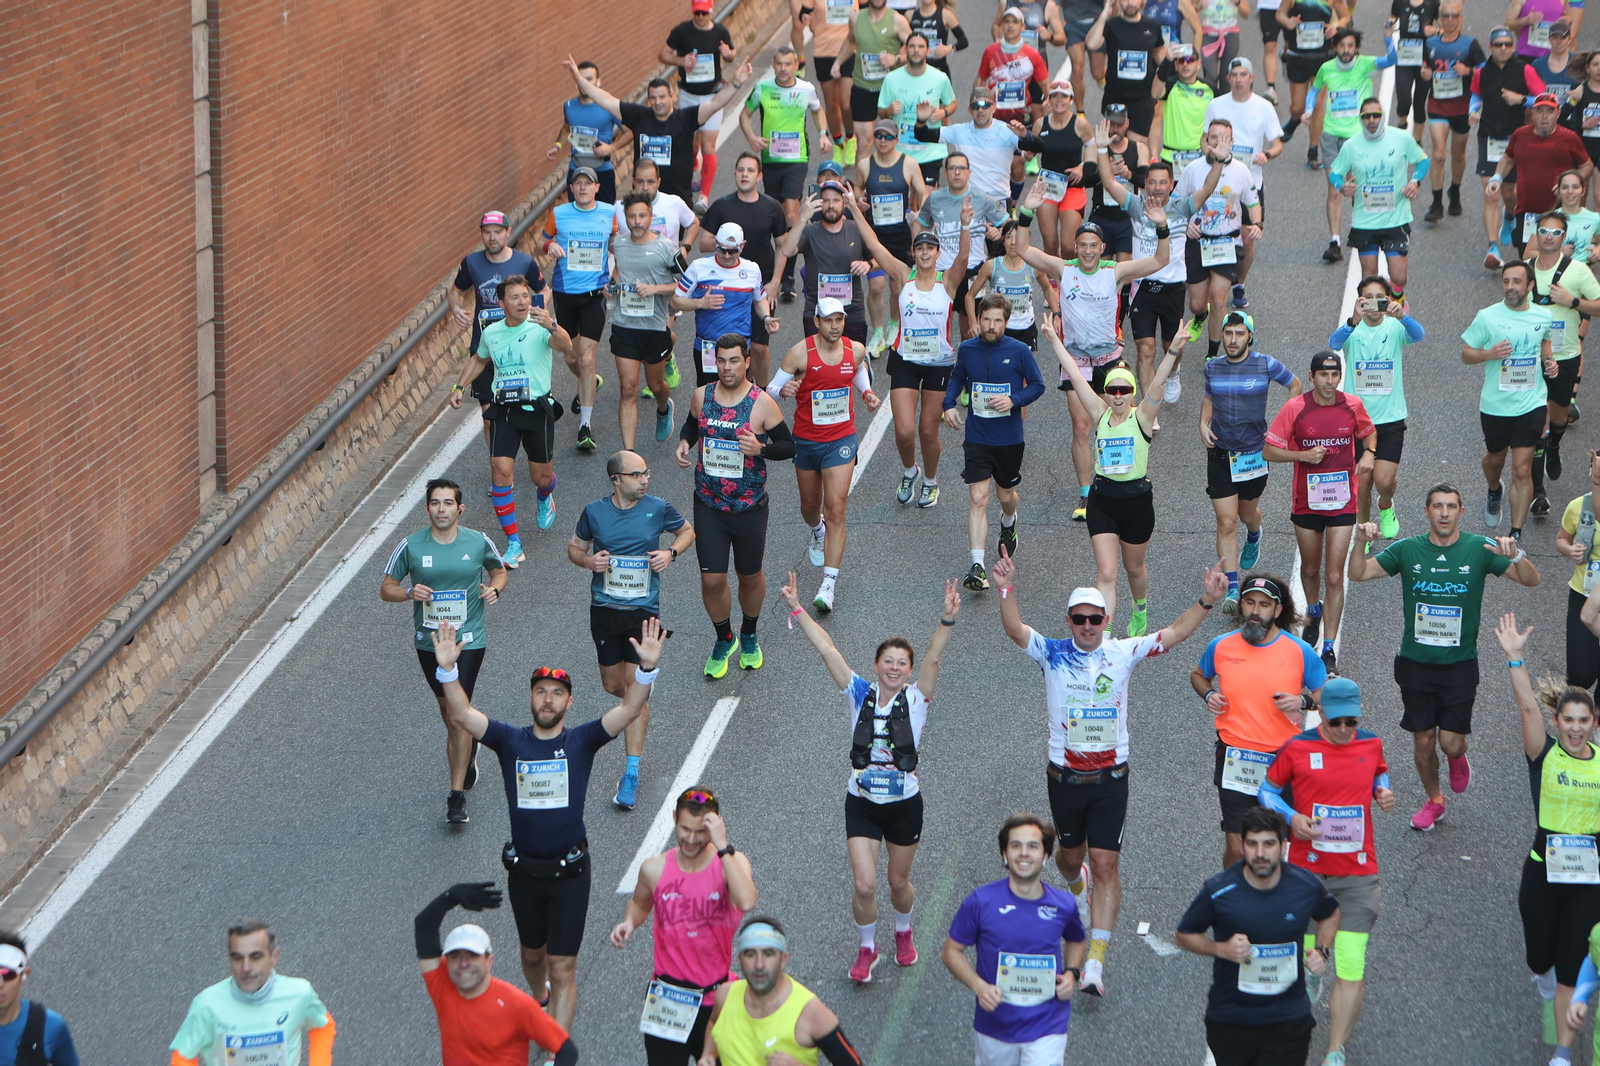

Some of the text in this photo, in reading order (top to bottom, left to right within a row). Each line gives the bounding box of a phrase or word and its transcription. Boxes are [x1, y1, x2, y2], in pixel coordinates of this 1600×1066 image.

[1513, 358, 1534, 366] ZURICH
[505, 379, 526, 387] ZURICH
[707, 418, 739, 429] SAYSKY
[1302, 436, 1351, 448] CUATRECASAS
[1327, 447, 1340, 455] Club
[1322, 475, 1344, 483] ZURICH
[1412, 580, 1466, 594] MADRID
[436, 593, 461, 601] ZURICH
[436, 606, 451, 614] 9044
[1431, 608, 1456, 616] ZURICH
[440, 613, 461, 621] LORENTE
[1085, 710, 1113, 718] ZURICH
[1084, 725, 1104, 733] 10048
[1242, 753, 1269, 763] ZURICH
[532, 763, 561, 772] ZURICH
[530, 780, 551, 788] 10087
[869, 777, 890, 785] 12892
[1330, 809, 1358, 818] ZURICH
[1329, 824, 1347, 832] 7897
[1565, 838, 1591, 847] ZURICH
[1261, 946, 1292, 957] ZURICH
[1020, 958, 1049, 968] ZURICH
[1016, 975, 1038, 984] 10138
[665, 989, 695, 1004] ZURICH
[245, 1033, 278, 1045] ZURICH
